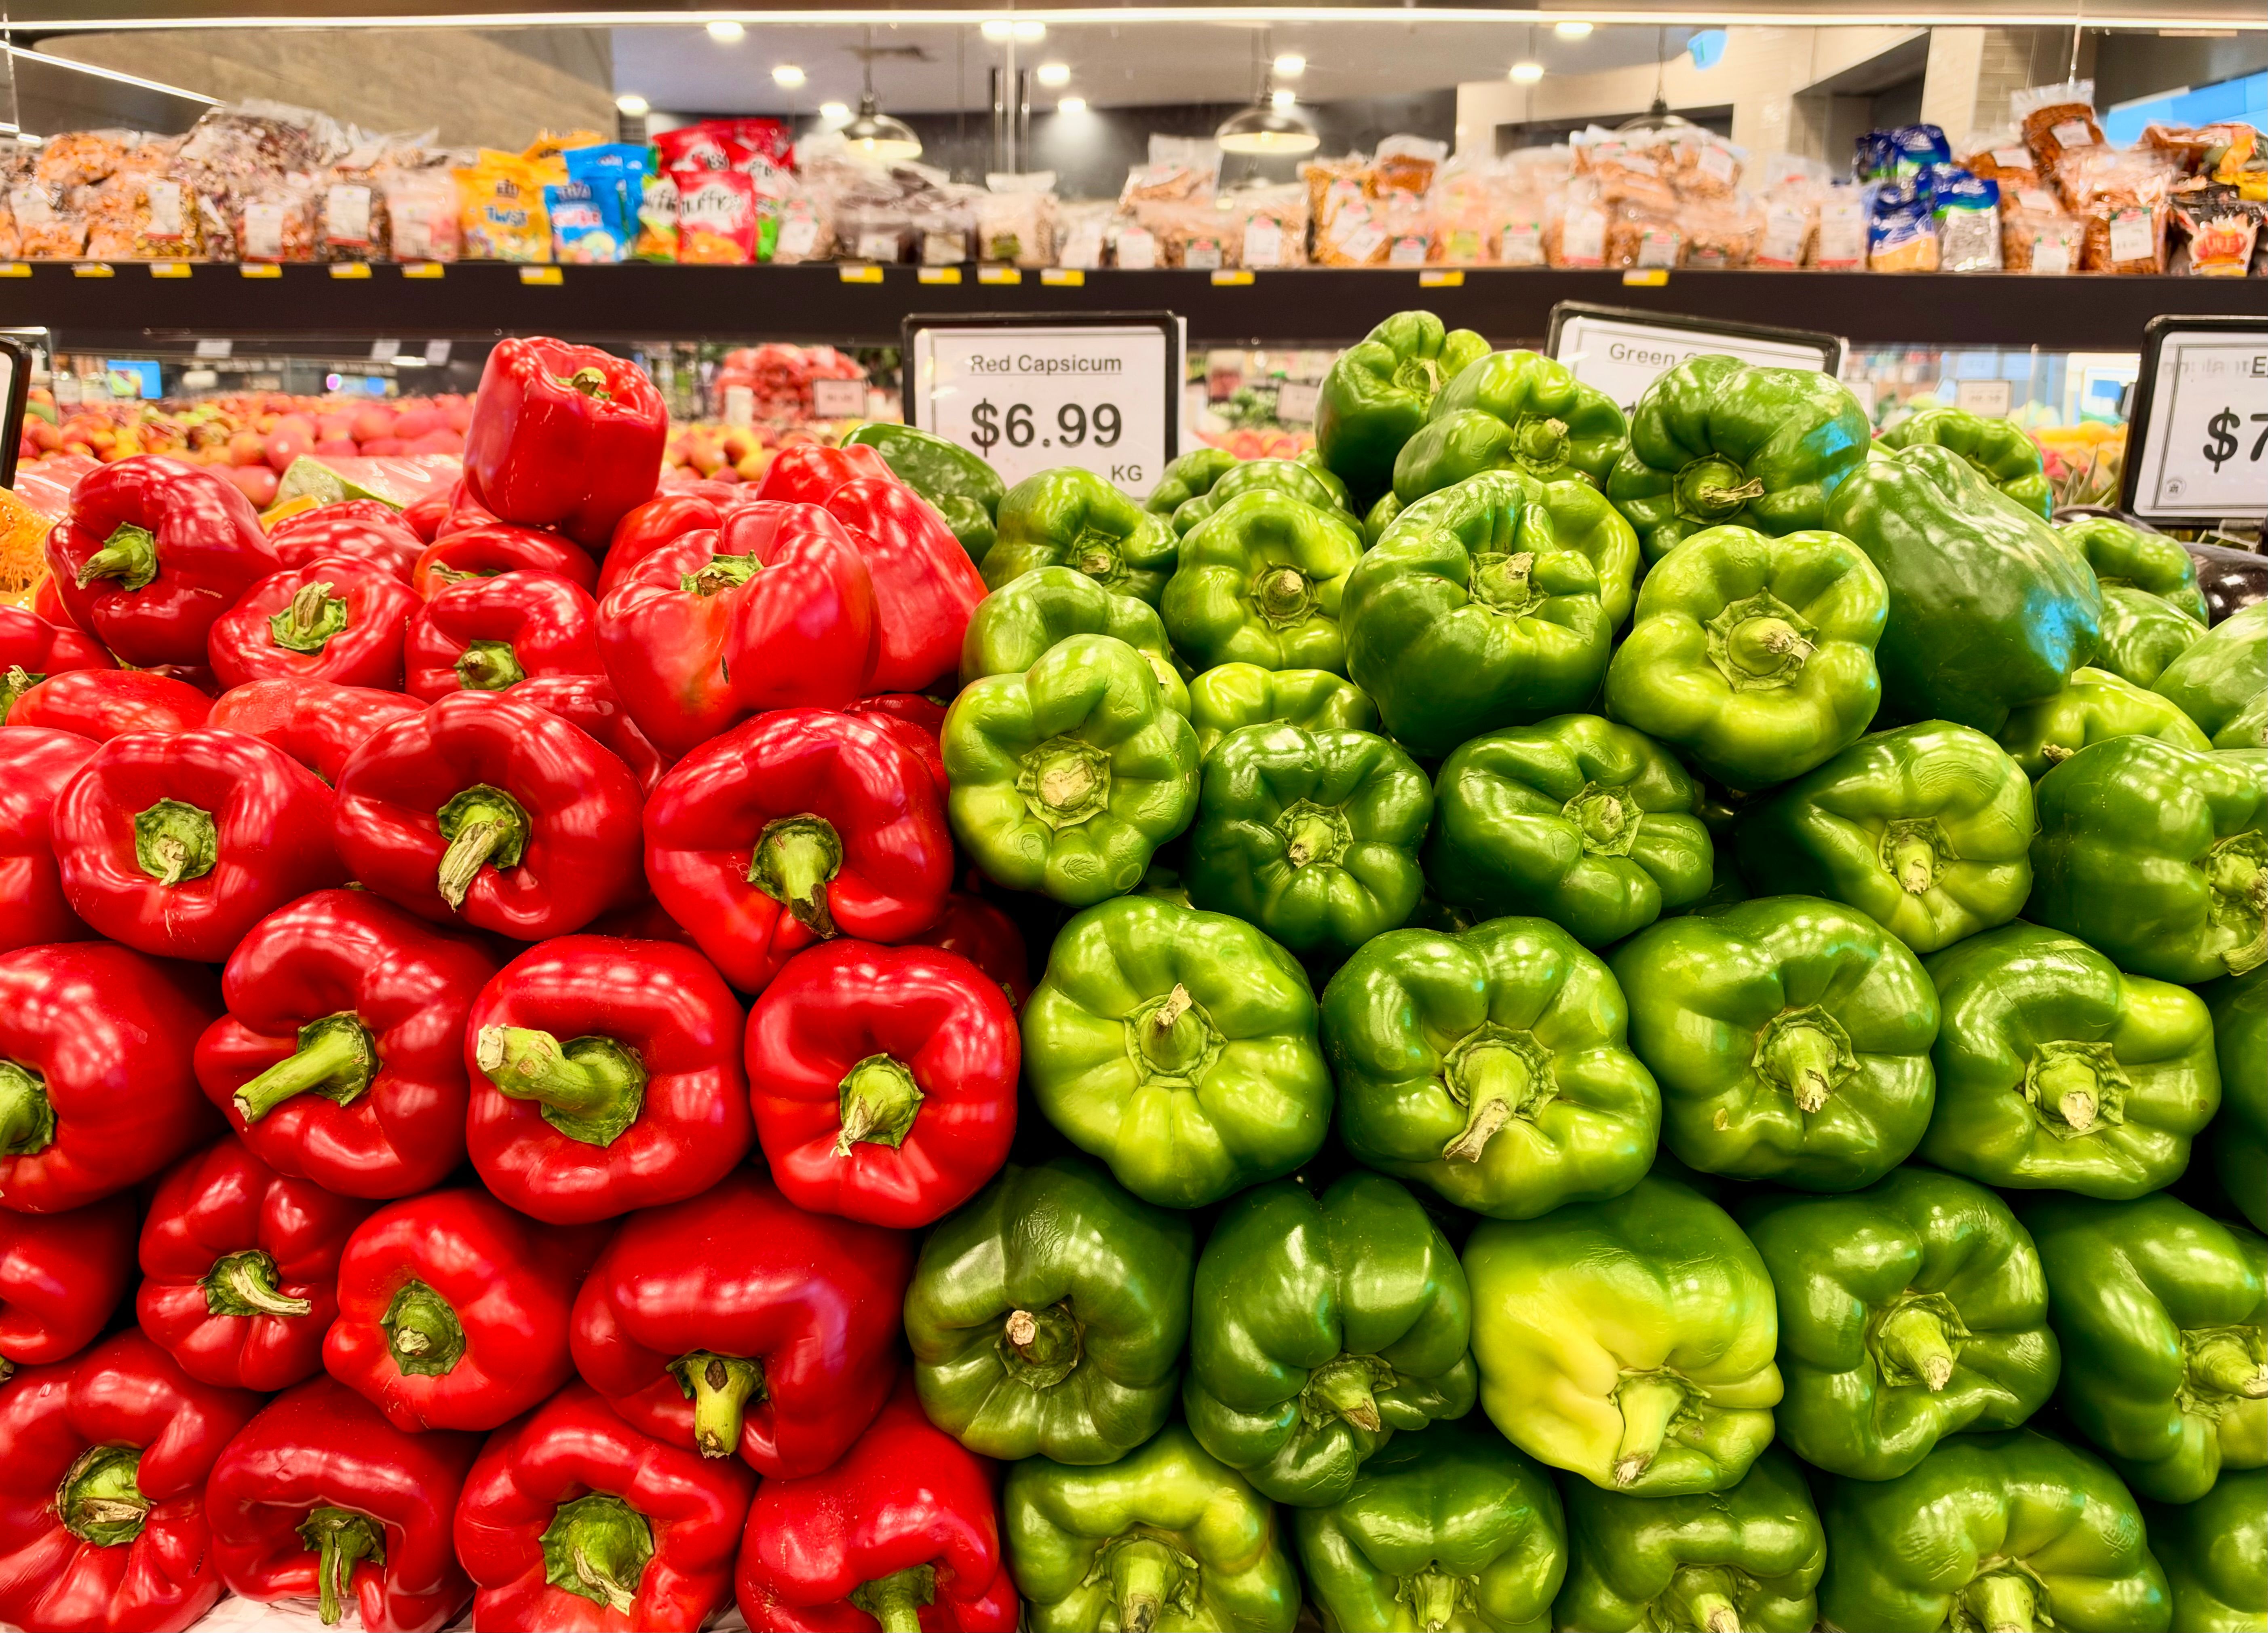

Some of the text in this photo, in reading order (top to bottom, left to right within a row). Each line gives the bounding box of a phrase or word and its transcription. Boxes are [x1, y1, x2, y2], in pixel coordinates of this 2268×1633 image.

[971, 354, 1122, 375] Red Capsicum
[1609, 342, 1676, 365] Green
[970, 397, 1122, 458] $6.99
[1111, 465, 1143, 482] KG
